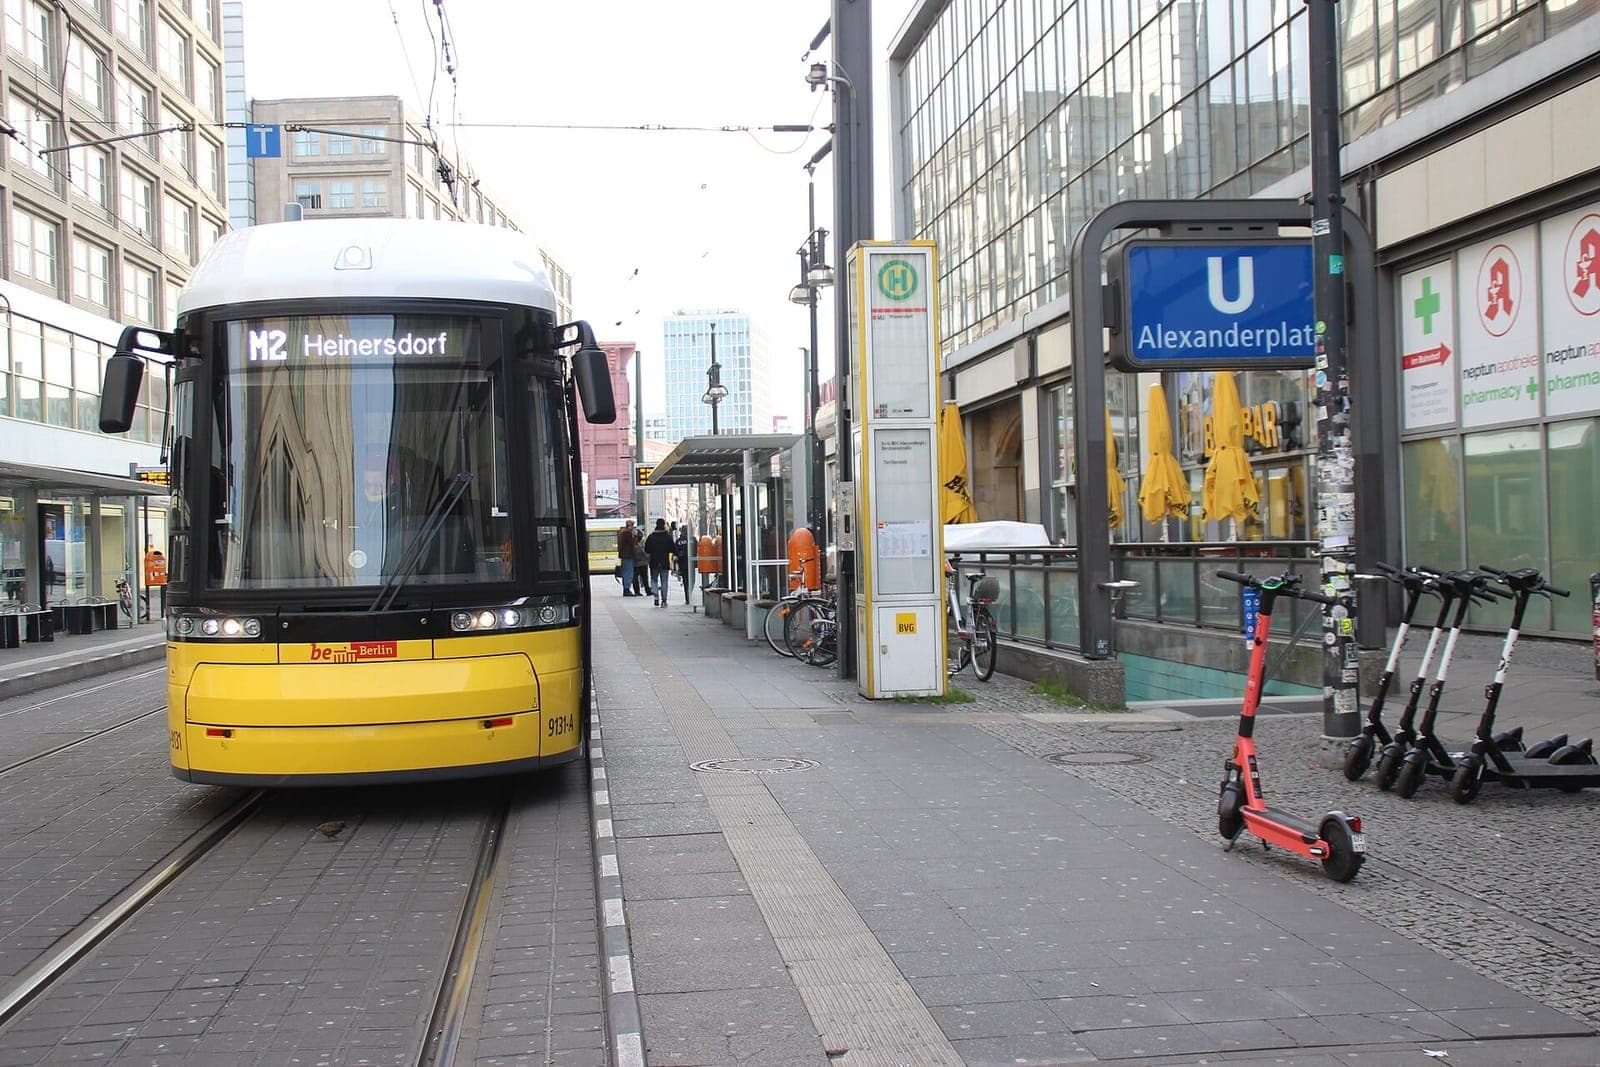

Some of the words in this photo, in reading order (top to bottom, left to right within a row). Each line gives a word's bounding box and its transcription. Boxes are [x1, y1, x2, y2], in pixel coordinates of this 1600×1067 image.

[253, 127, 274, 155] T
[888, 269, 908, 291] H
[1207, 256, 1254, 314] U
[249, 329, 288, 361] M2
[304, 332, 447, 358] Heinersdorf
[1138, 321, 1314, 352] Alexanderplat
[1546, 345, 1586, 364] neptun
[1463, 384, 1522, 407] pharmacy
[898, 623, 915, 632] BVG
[310, 643, 332, 660] be
[359, 644, 393, 656] Berlin
